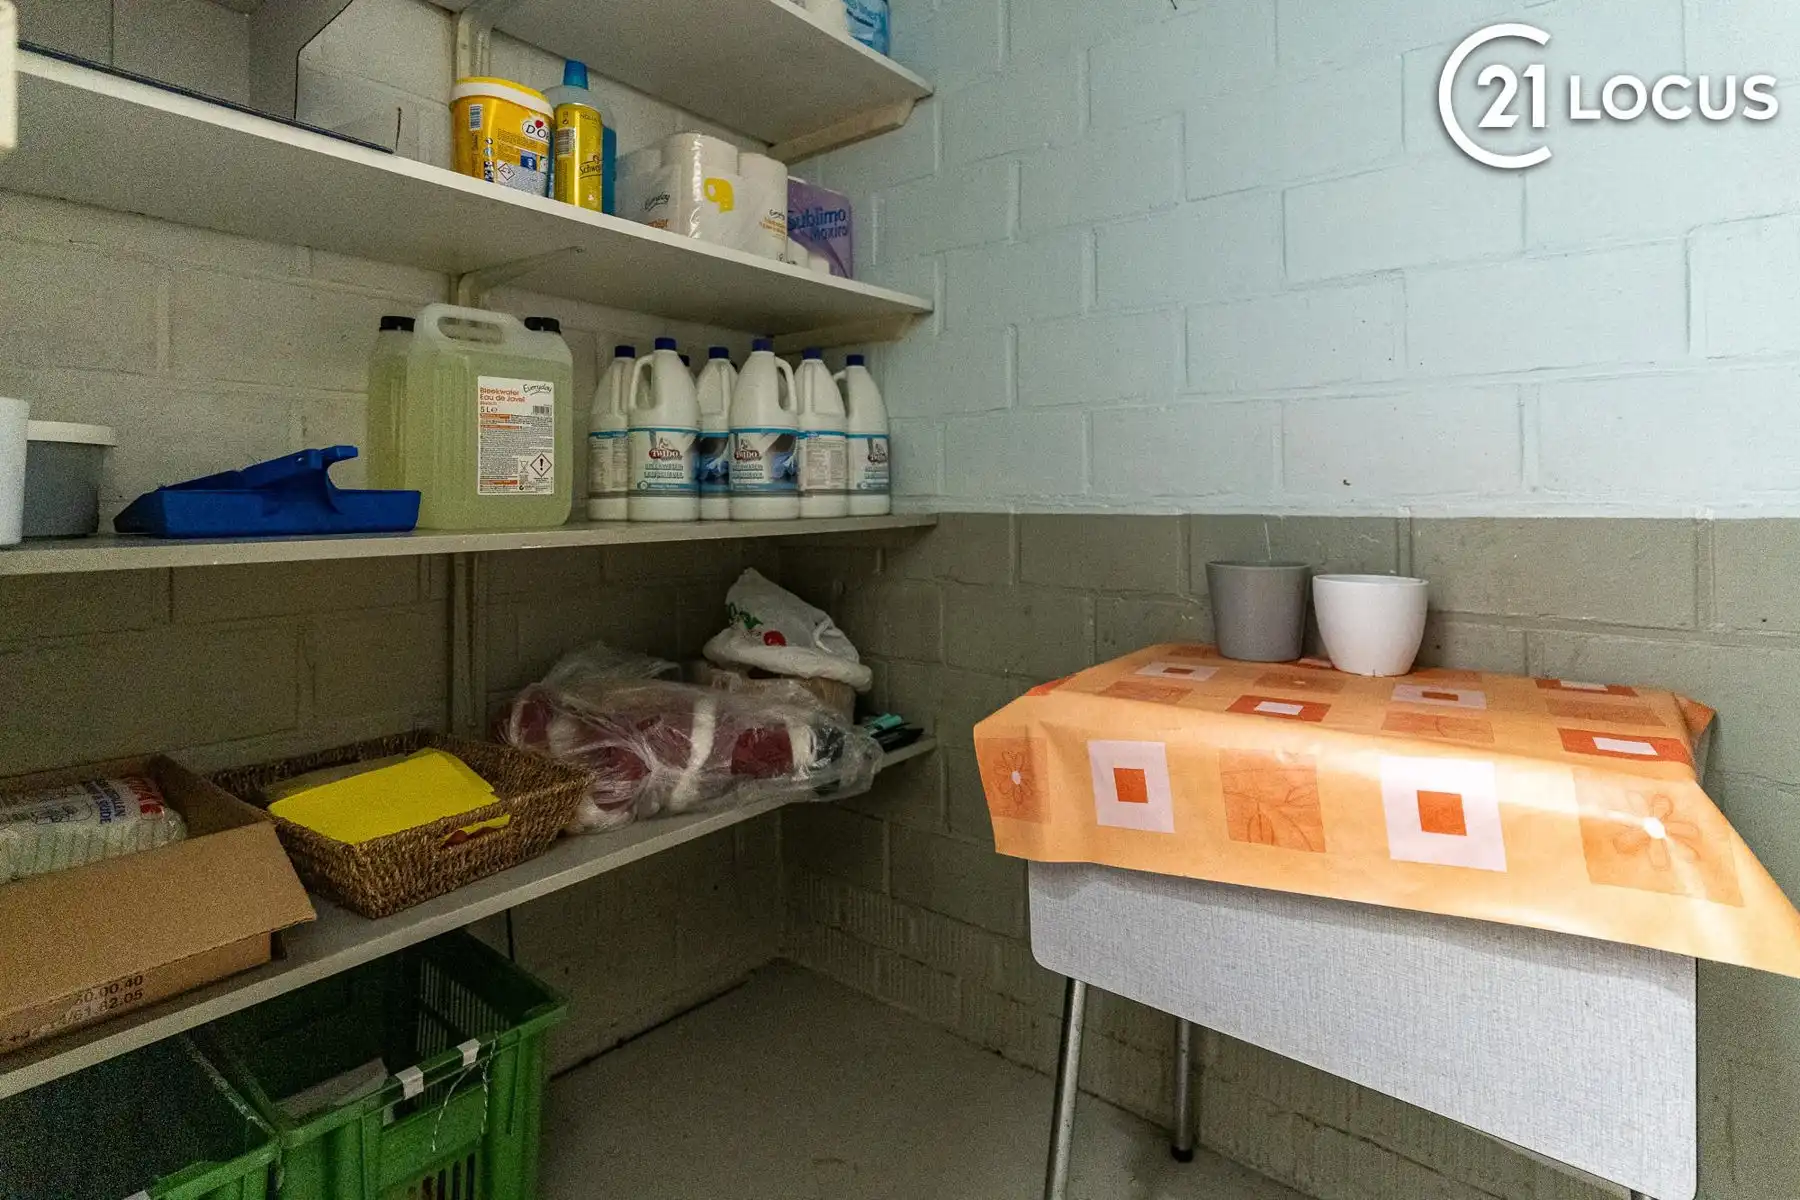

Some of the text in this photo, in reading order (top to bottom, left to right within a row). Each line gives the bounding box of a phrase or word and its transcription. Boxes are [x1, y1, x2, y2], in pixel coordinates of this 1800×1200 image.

[480, 387, 519, 395] Bleekwater
[523, 384, 552, 393] Everyday
[496, 394, 505, 402] de
